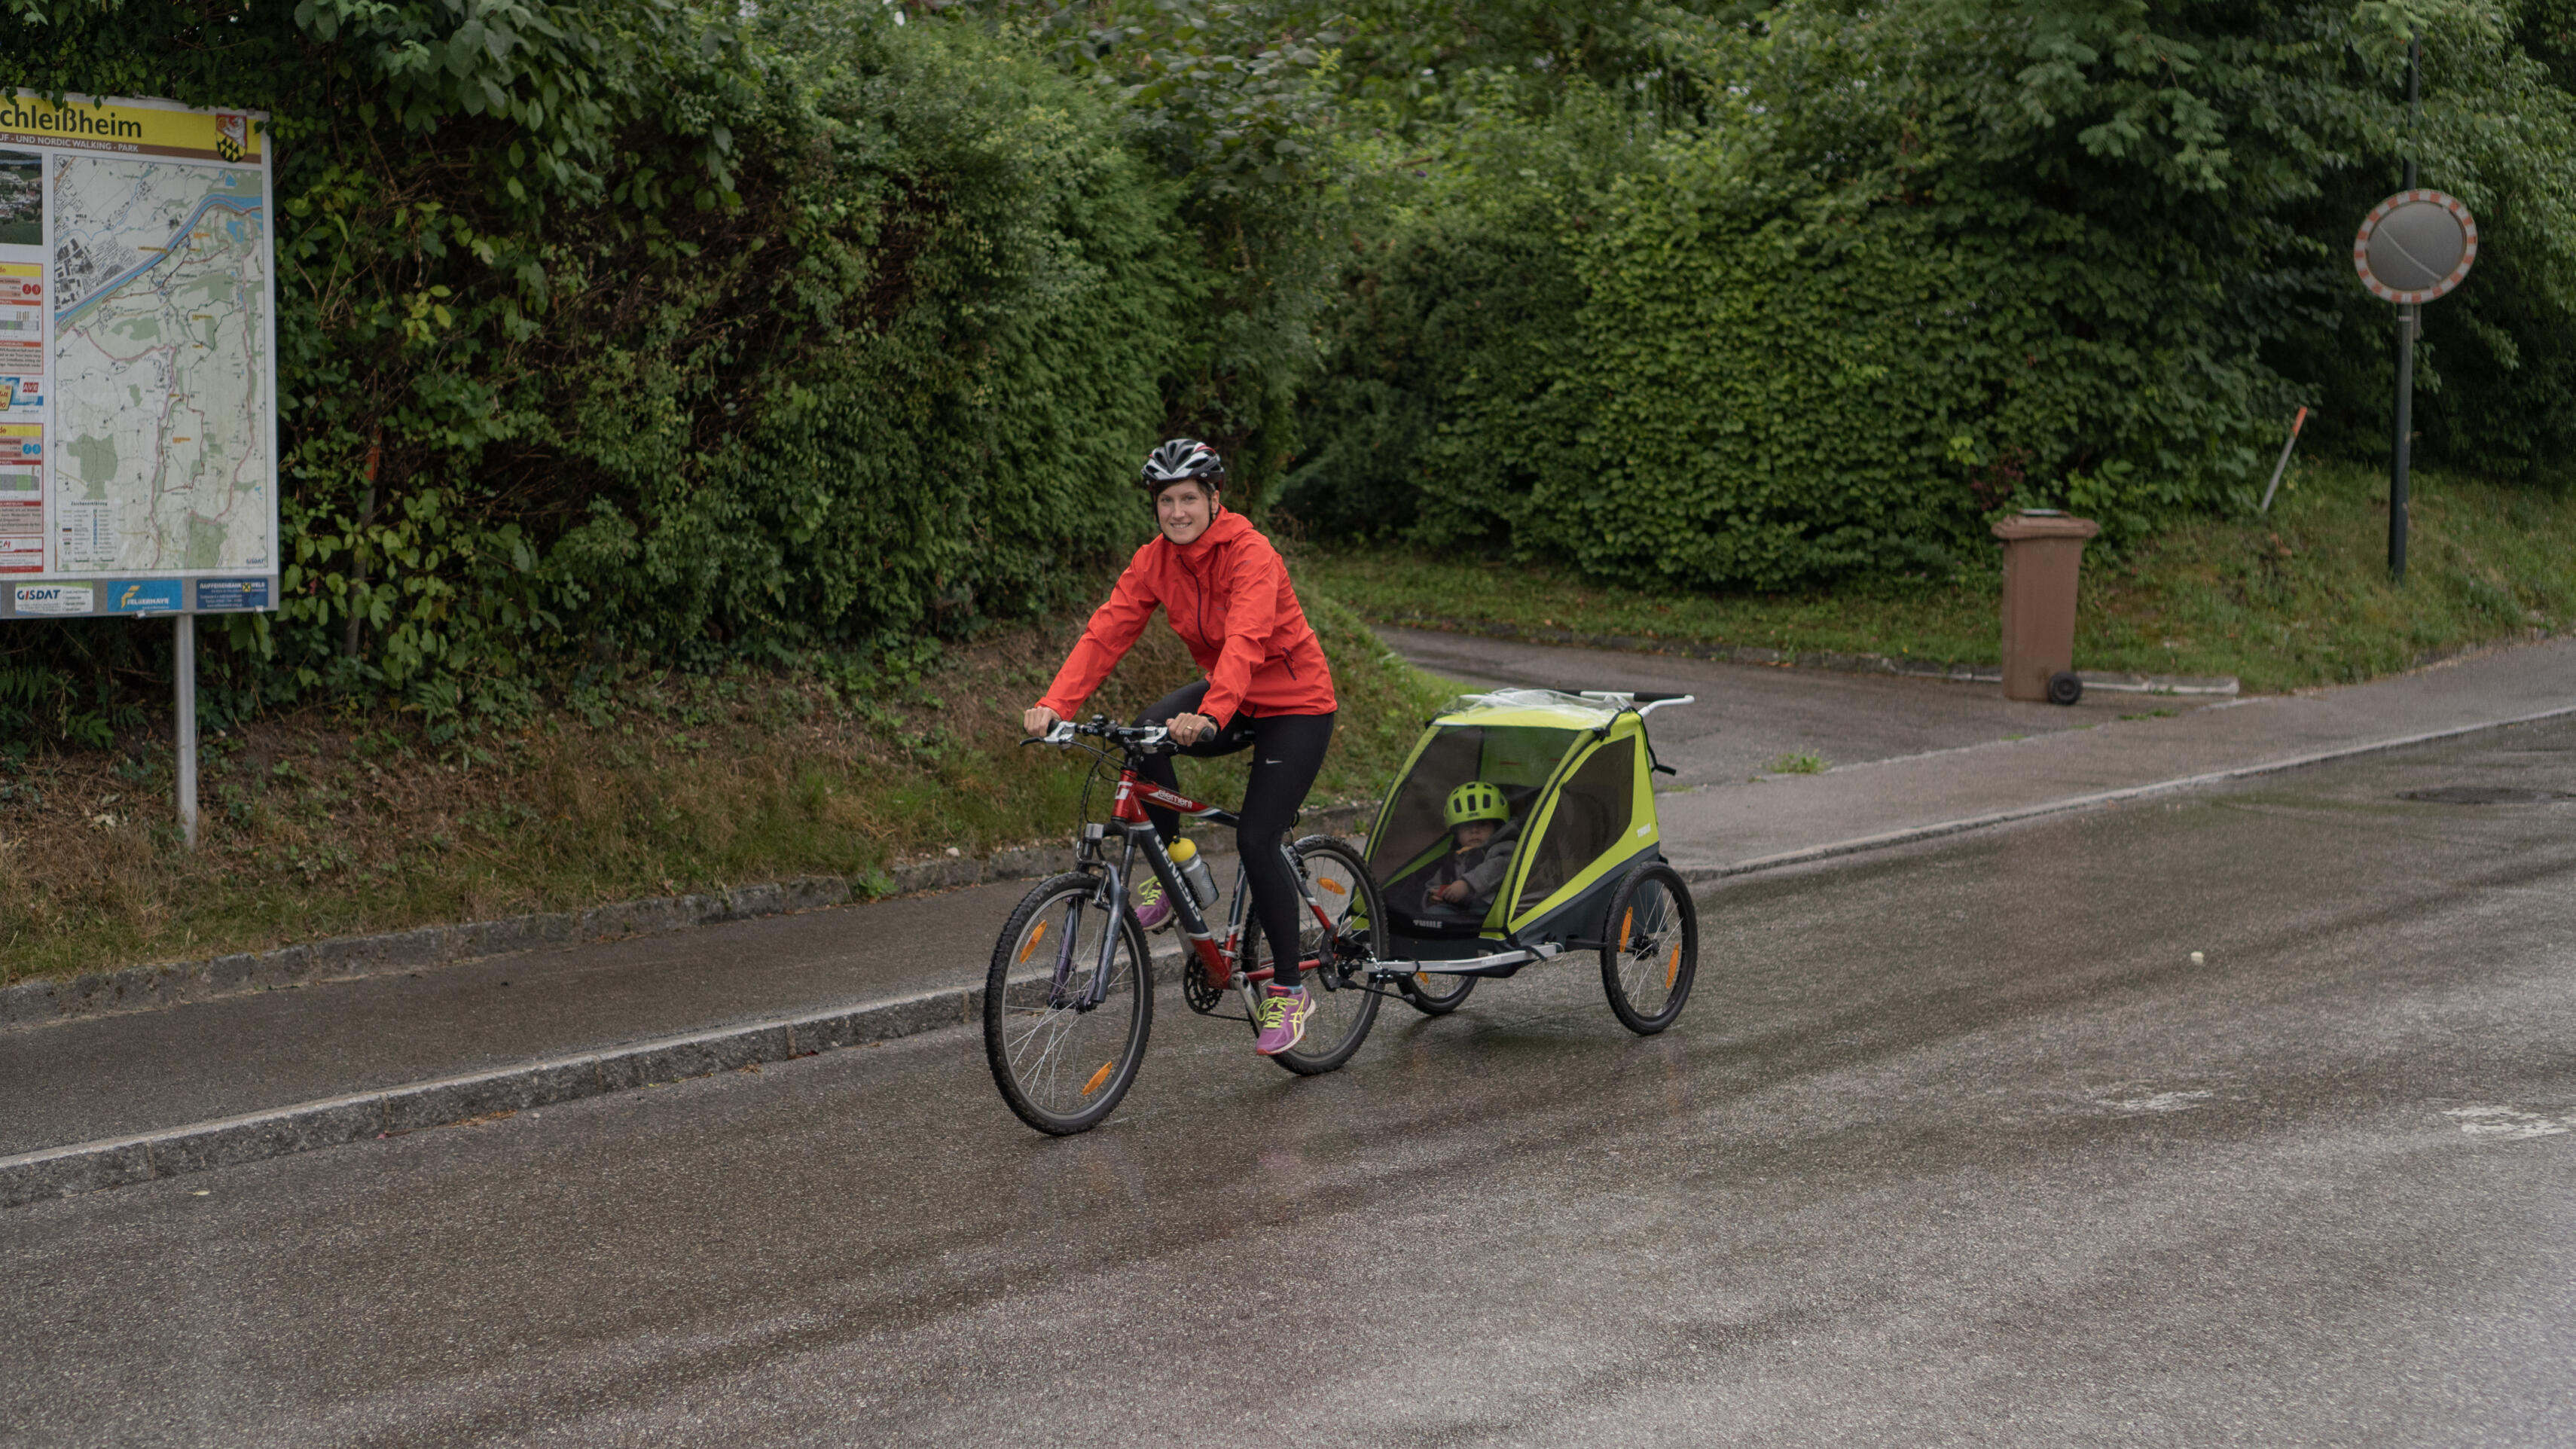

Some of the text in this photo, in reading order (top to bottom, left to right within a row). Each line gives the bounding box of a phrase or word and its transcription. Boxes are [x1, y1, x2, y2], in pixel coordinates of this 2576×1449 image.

[16, 135, 35, 144] UND
[38, 136, 71, 147] NORDIC
[72, 139, 111, 151] WALKING
[118, 143, 139, 152] PARK
[17, 590, 60, 600] GISDAT
[1158, 789, 1193, 809] element
[1413, 920, 1442, 928] THULE
